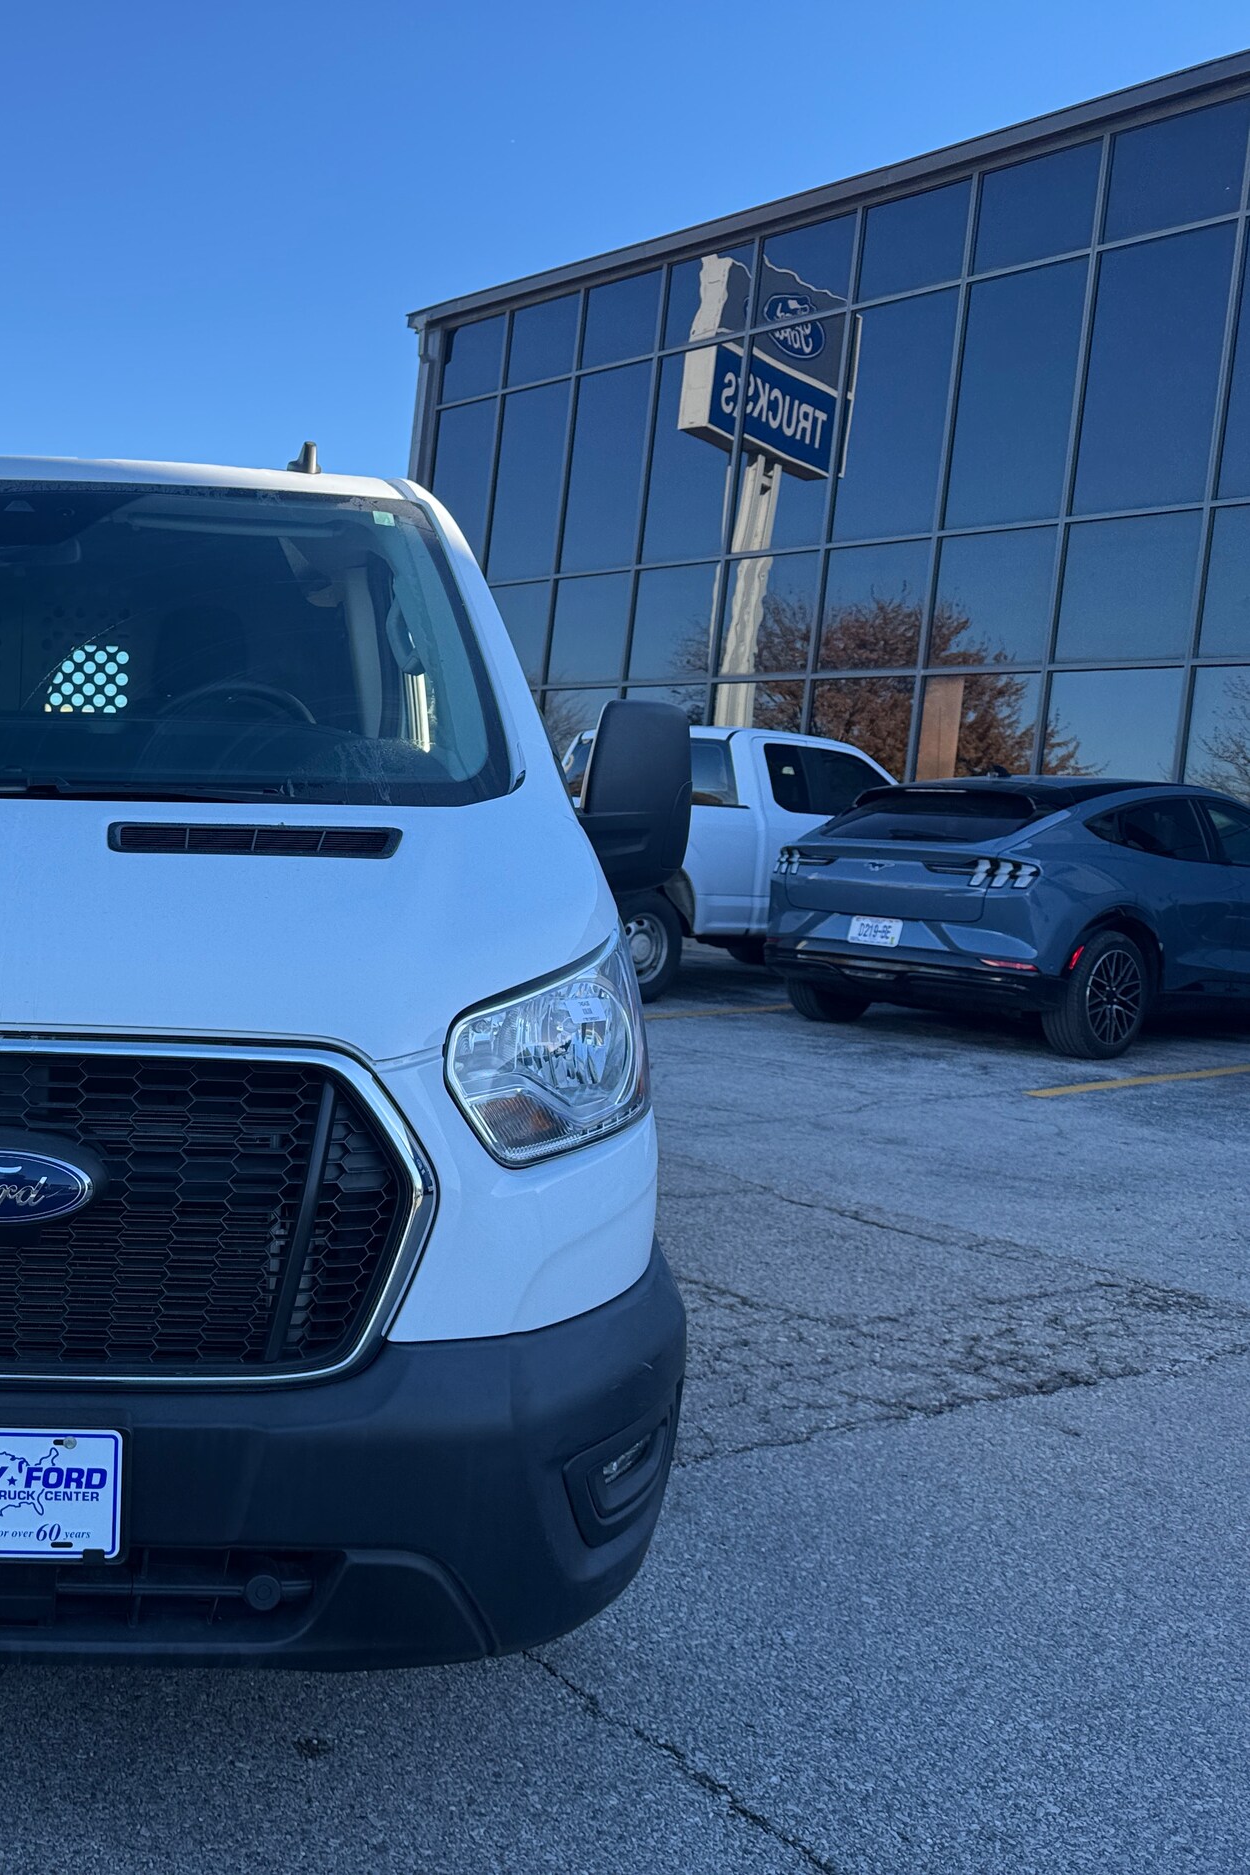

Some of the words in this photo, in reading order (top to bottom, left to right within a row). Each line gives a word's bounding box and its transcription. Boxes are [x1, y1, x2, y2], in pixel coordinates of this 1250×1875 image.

[24, 1467, 108, 1490] FORD
[44, 1491, 100, 1502] CENTER
[11, 1530, 34, 1539] over
[35, 1523, 61, 1542] 60
[64, 1530, 91, 1541] years
